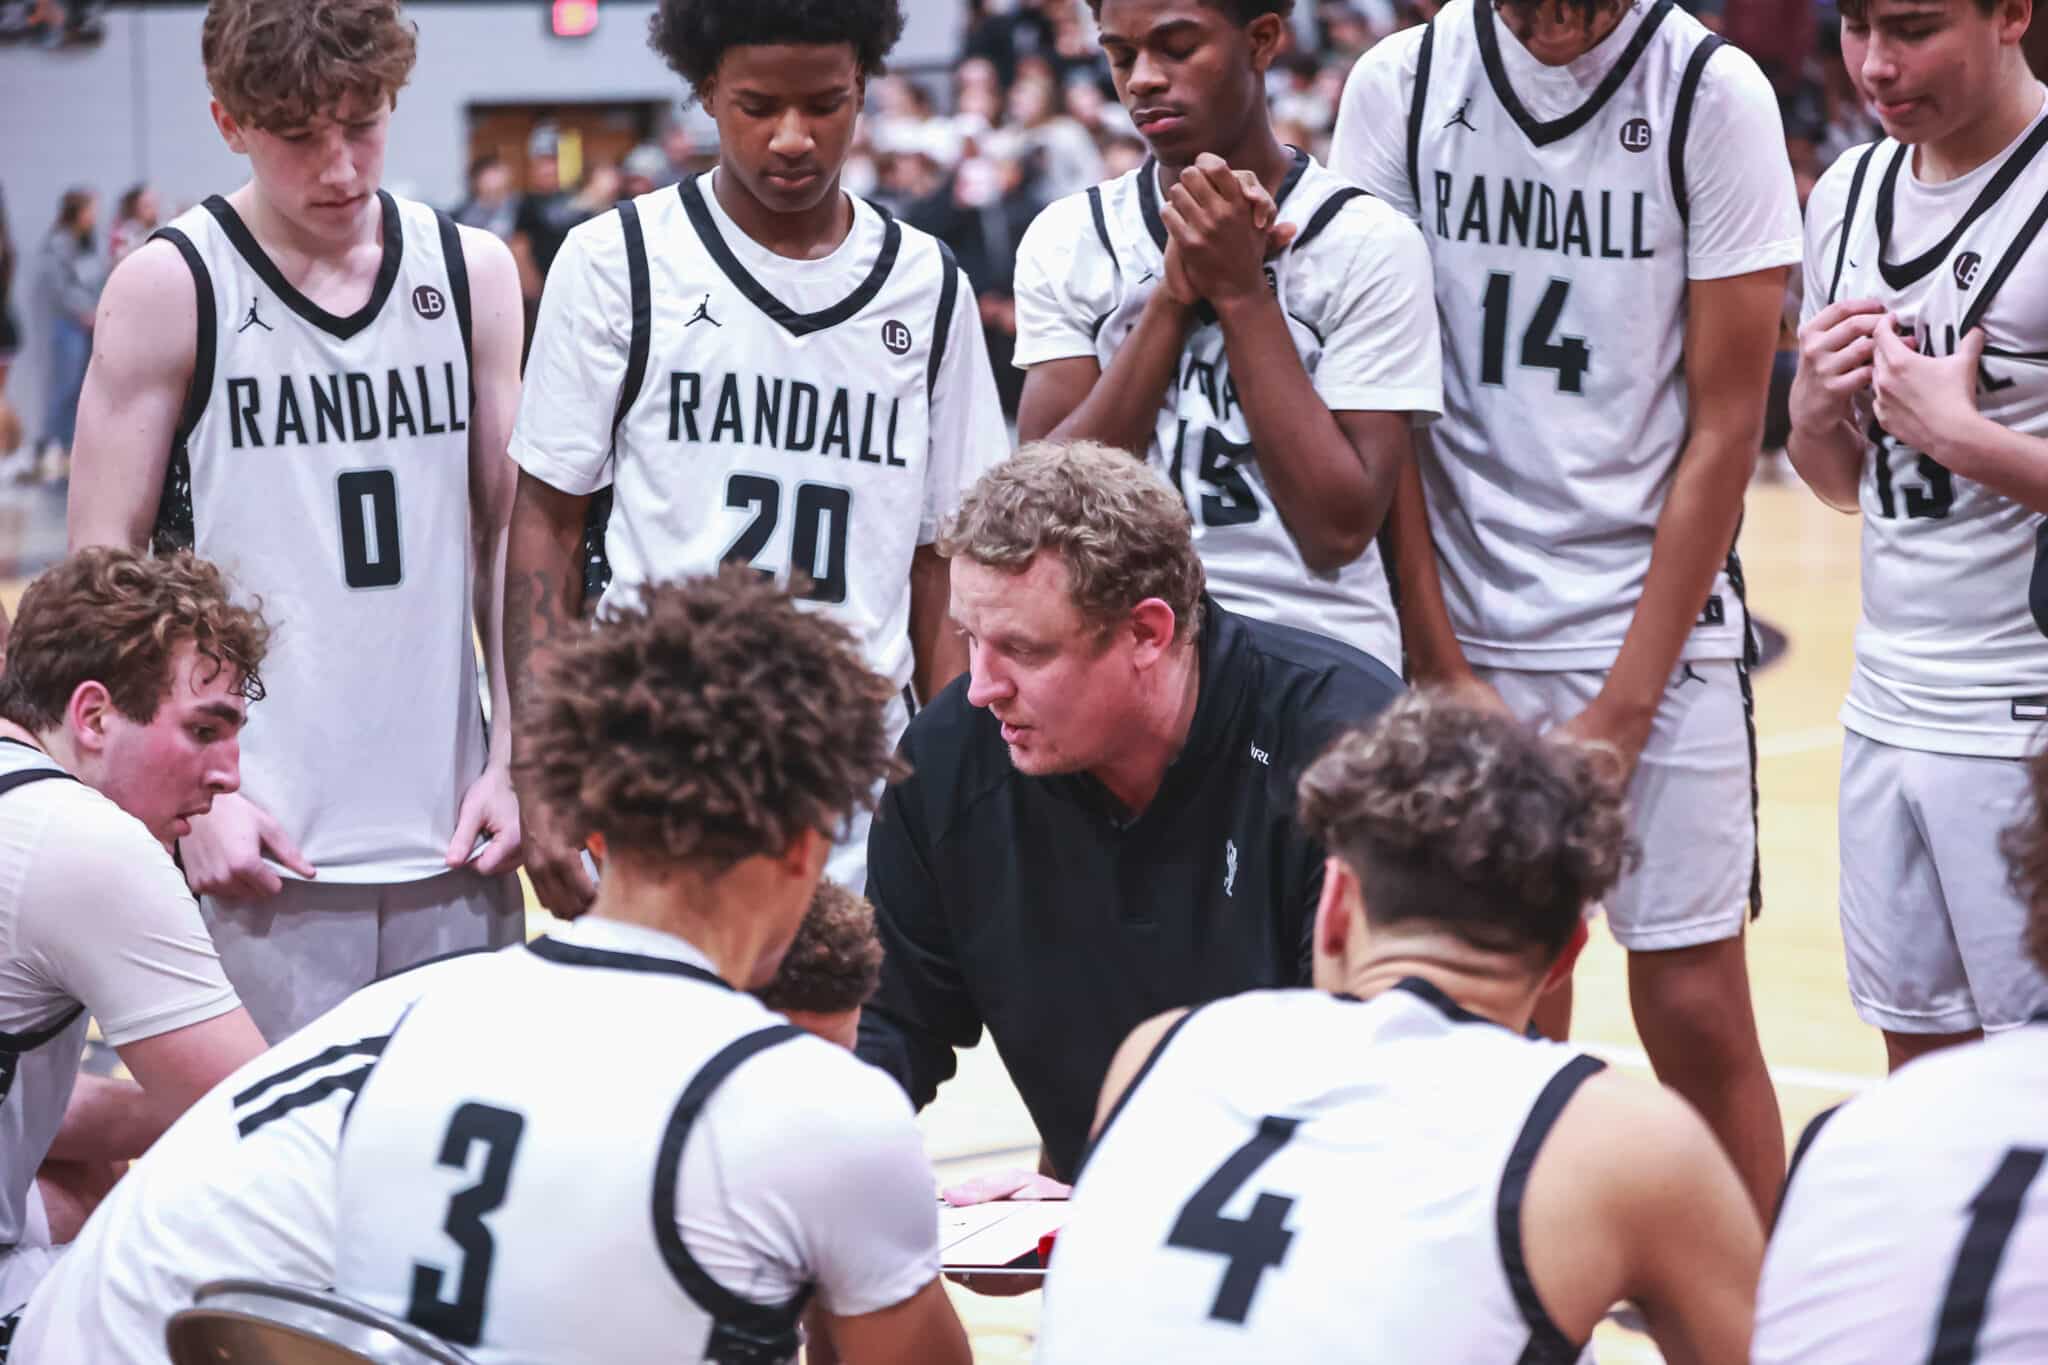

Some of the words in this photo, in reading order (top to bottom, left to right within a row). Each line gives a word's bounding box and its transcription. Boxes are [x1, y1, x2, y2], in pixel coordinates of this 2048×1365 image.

[1623, 124, 1650, 146] LB
[1433, 168, 1656, 260] RANDALL
[414, 291, 442, 313] LB
[885, 324, 909, 349] LB
[1479, 271, 1591, 395] 14
[226, 361, 466, 449] RANDALL
[668, 370, 907, 468] RANDALL
[1169, 419, 1260, 527] 15
[336, 469, 402, 589] 0
[718, 473, 851, 605] 20
[408, 1101, 525, 1346] 3
[1167, 1115, 1301, 1325] 4
